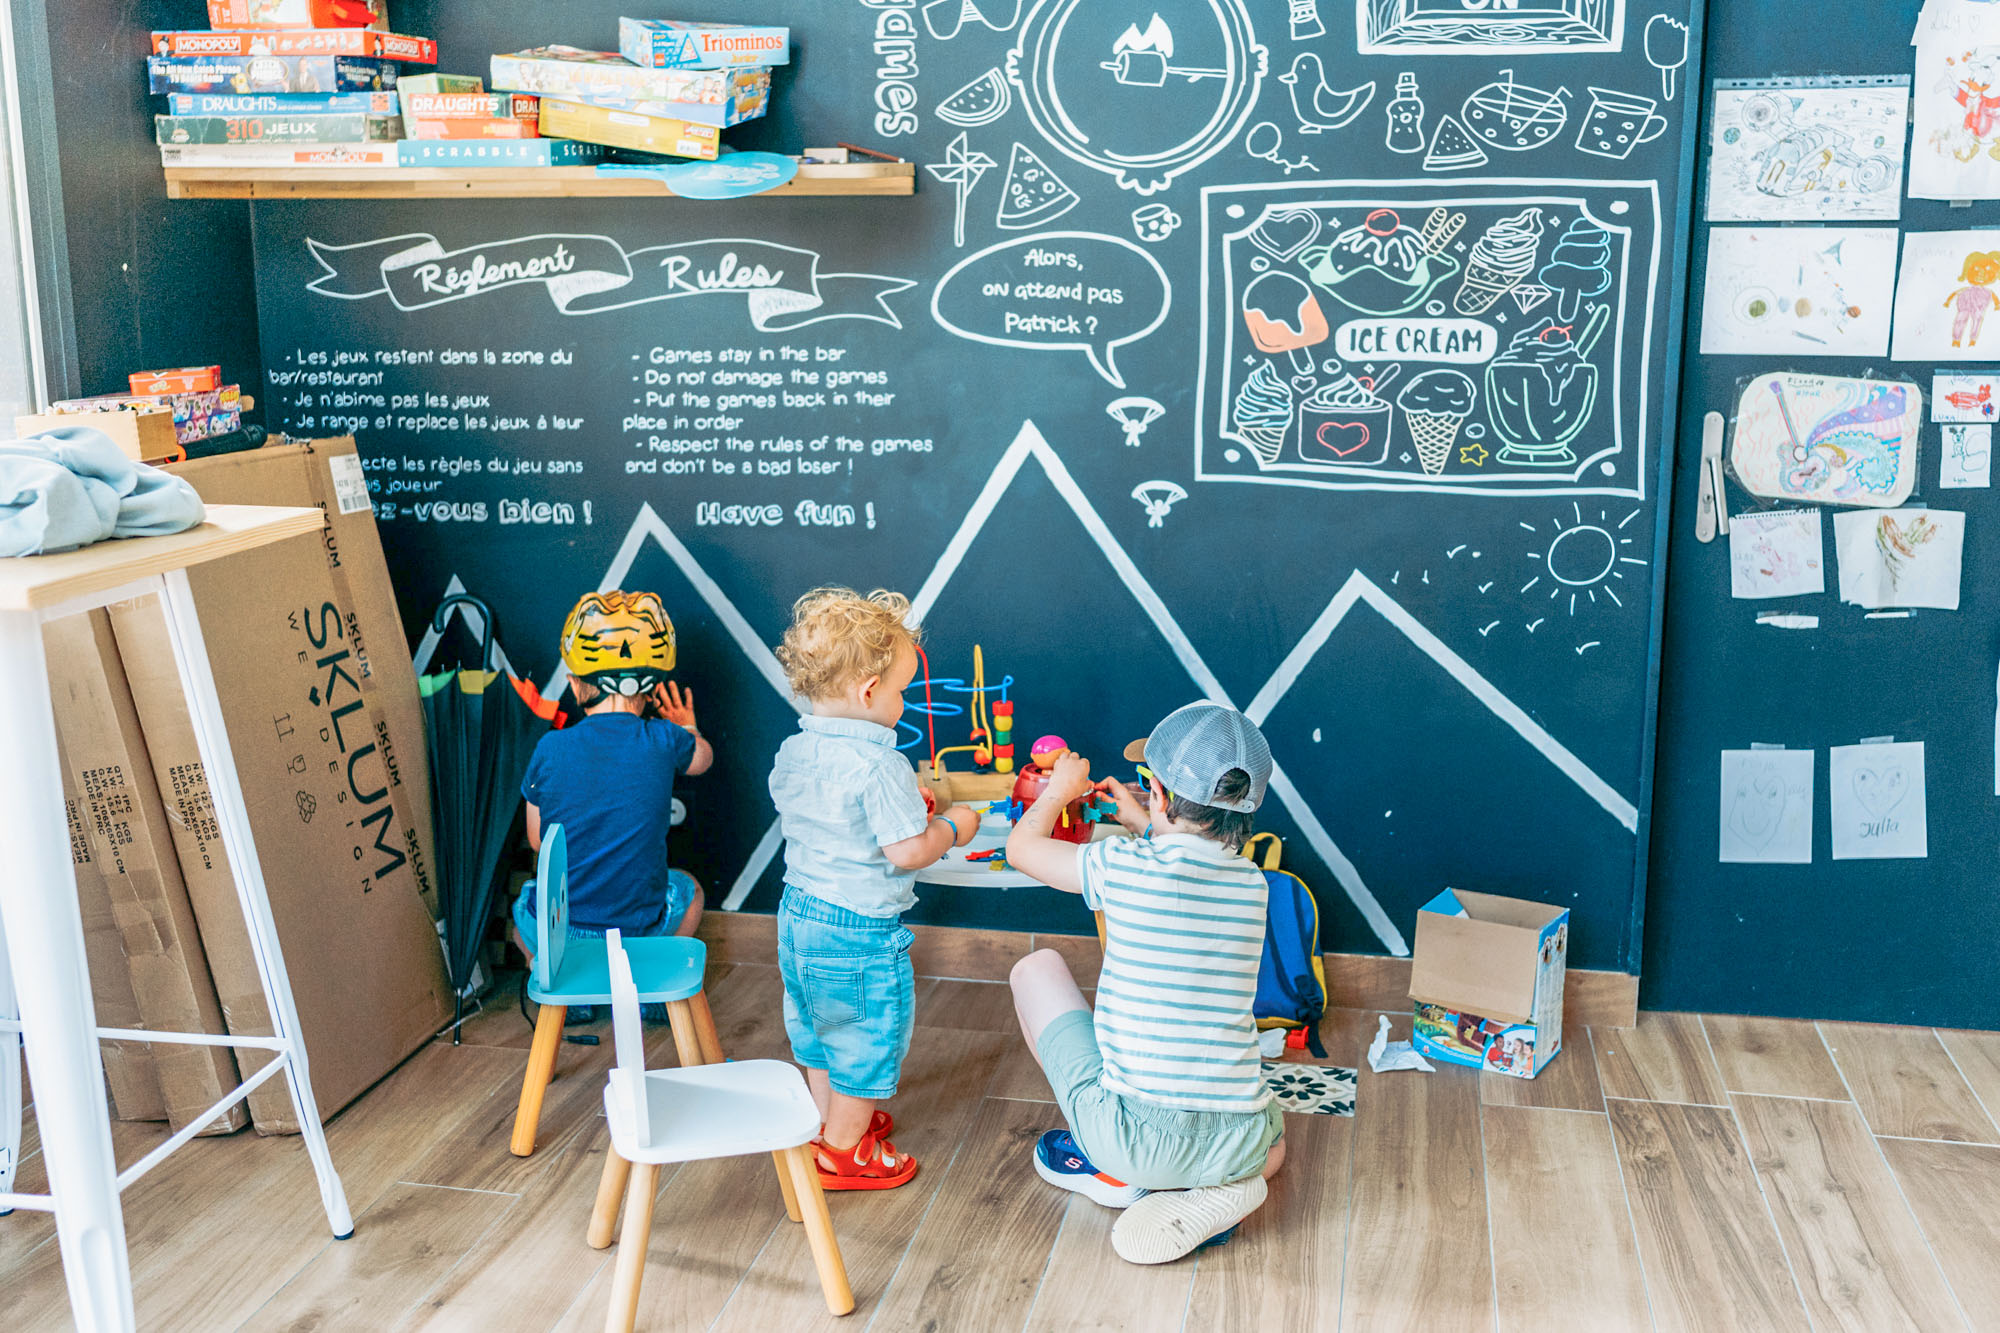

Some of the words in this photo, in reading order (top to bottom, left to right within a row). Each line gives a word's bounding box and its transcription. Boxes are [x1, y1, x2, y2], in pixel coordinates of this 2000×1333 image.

[179, 38, 239, 51] MONOPOLY
[385, 39, 419, 55] MONOPOLY
[701, 33, 783, 52] Triominos
[862, 0, 919, 137] ames
[202, 97, 277, 112] DRAUGHTS
[412, 97, 499, 112] DRAUGHTS
[226, 119, 263, 139] 310
[265, 122, 316, 135] JEUX
[423, 146, 528, 158] SCRABBLE
[1024, 248, 1083, 271] Alors,
[660, 252, 784, 291] Rules
[1005, 312, 1081, 333] Patrick
[1350, 326, 1388, 353] ICE
[1395, 326, 1482, 354] CREAM
[297, 349, 327, 365] Les
[332, 350, 368, 367] jeux
[375, 349, 433, 364] restent
[440, 348, 478, 364] dans
[484, 349, 496, 364] la
[502, 351, 544, 365] zone
[550, 349, 572, 364] du
[650, 347, 712, 364] Games
[718, 348, 752, 365] stay
[759, 347, 774, 361] in
[780, 345, 808, 362] the
[815, 346, 846, 361] bar
[269, 369, 383, 386] bar/restaurant
[645, 369, 671, 385] Do
[677, 371, 706, 385] not
[711, 370, 784, 388] damage
[791, 369, 819, 384] the
[826, 371, 888, 388] games
[295, 392, 312, 407] Je
[320, 391, 385, 407] n'abime
[391, 395, 419, 409] pas
[425, 392, 448, 408] les
[452, 395, 490, 410] jeux
[646, 391, 675, 407] Put
[682, 392, 710, 408] the
[717, 394, 776, 411] games
[783, 390, 826, 407] back
[833, 392, 848, 405] in
[854, 391, 895, 406] their
[297, 414, 314, 428] Je
[321, 415, 368, 434] range
[375, 414, 392, 429] et
[398, 413, 459, 433] replace
[465, 414, 487, 430] les
[491, 416, 530, 431] jeux
[553, 415, 584, 429] leur
[623, 414, 667, 432] place
[674, 415, 688, 429] in
[694, 414, 743, 431] order
[649, 436, 719, 454] Respect
[726, 437, 754, 452] the
[761, 436, 804, 452] rules
[810, 436, 829, 451] of
[835, 436, 864, 452] the
[871, 439, 933, 456] games
[403, 456, 425, 471] les
[431, 456, 481, 476] règles
[487, 457, 508, 472] du
[513, 458, 541, 474] jeu
[547, 461, 583, 473] sans
[625, 459, 656, 473] and
[662, 458, 705, 474] don't
[712, 458, 735, 474] be
[742, 461, 752, 474] a
[758, 459, 791, 474] bad
[798, 457, 841, 474] loser
[386, 478, 442, 494] joueur
[499, 498, 574, 524] bien
[697, 502, 783, 526] Have
[794, 500, 855, 527] fun
[346, 612, 371, 679] SKLUM
[304, 602, 406, 880] SKLUM
[376, 721, 401, 787] SKLUM
[169, 767, 182, 796] MADE
[69, 800, 79, 820] PRC
[82, 770, 96, 800] MADE
[91, 802, 99, 813] IN
[95, 814, 105, 835] PRC
[122, 794, 133, 813] 1PC
[178, 798, 186, 809] IN
[319, 727, 372, 894] DESIGN
[90, 769, 104, 802] MEAS:
[116, 858, 125, 875] CM
[106, 796, 116, 816] 15.6
[114, 823, 125, 845] KGS
[114, 794, 124, 814] 12.7
[121, 821, 133, 844] KGS
[177, 765, 190, 798] MEAS:
[203, 855, 212, 870] CM
[181, 810, 192, 831] PRC
[208, 817, 220, 839] KGS
[1859, 816, 1900, 838] Julia
[200, 819, 212, 841] KGS
[79, 834, 91, 862] MADE
[405, 828, 430, 893] SKLUM
